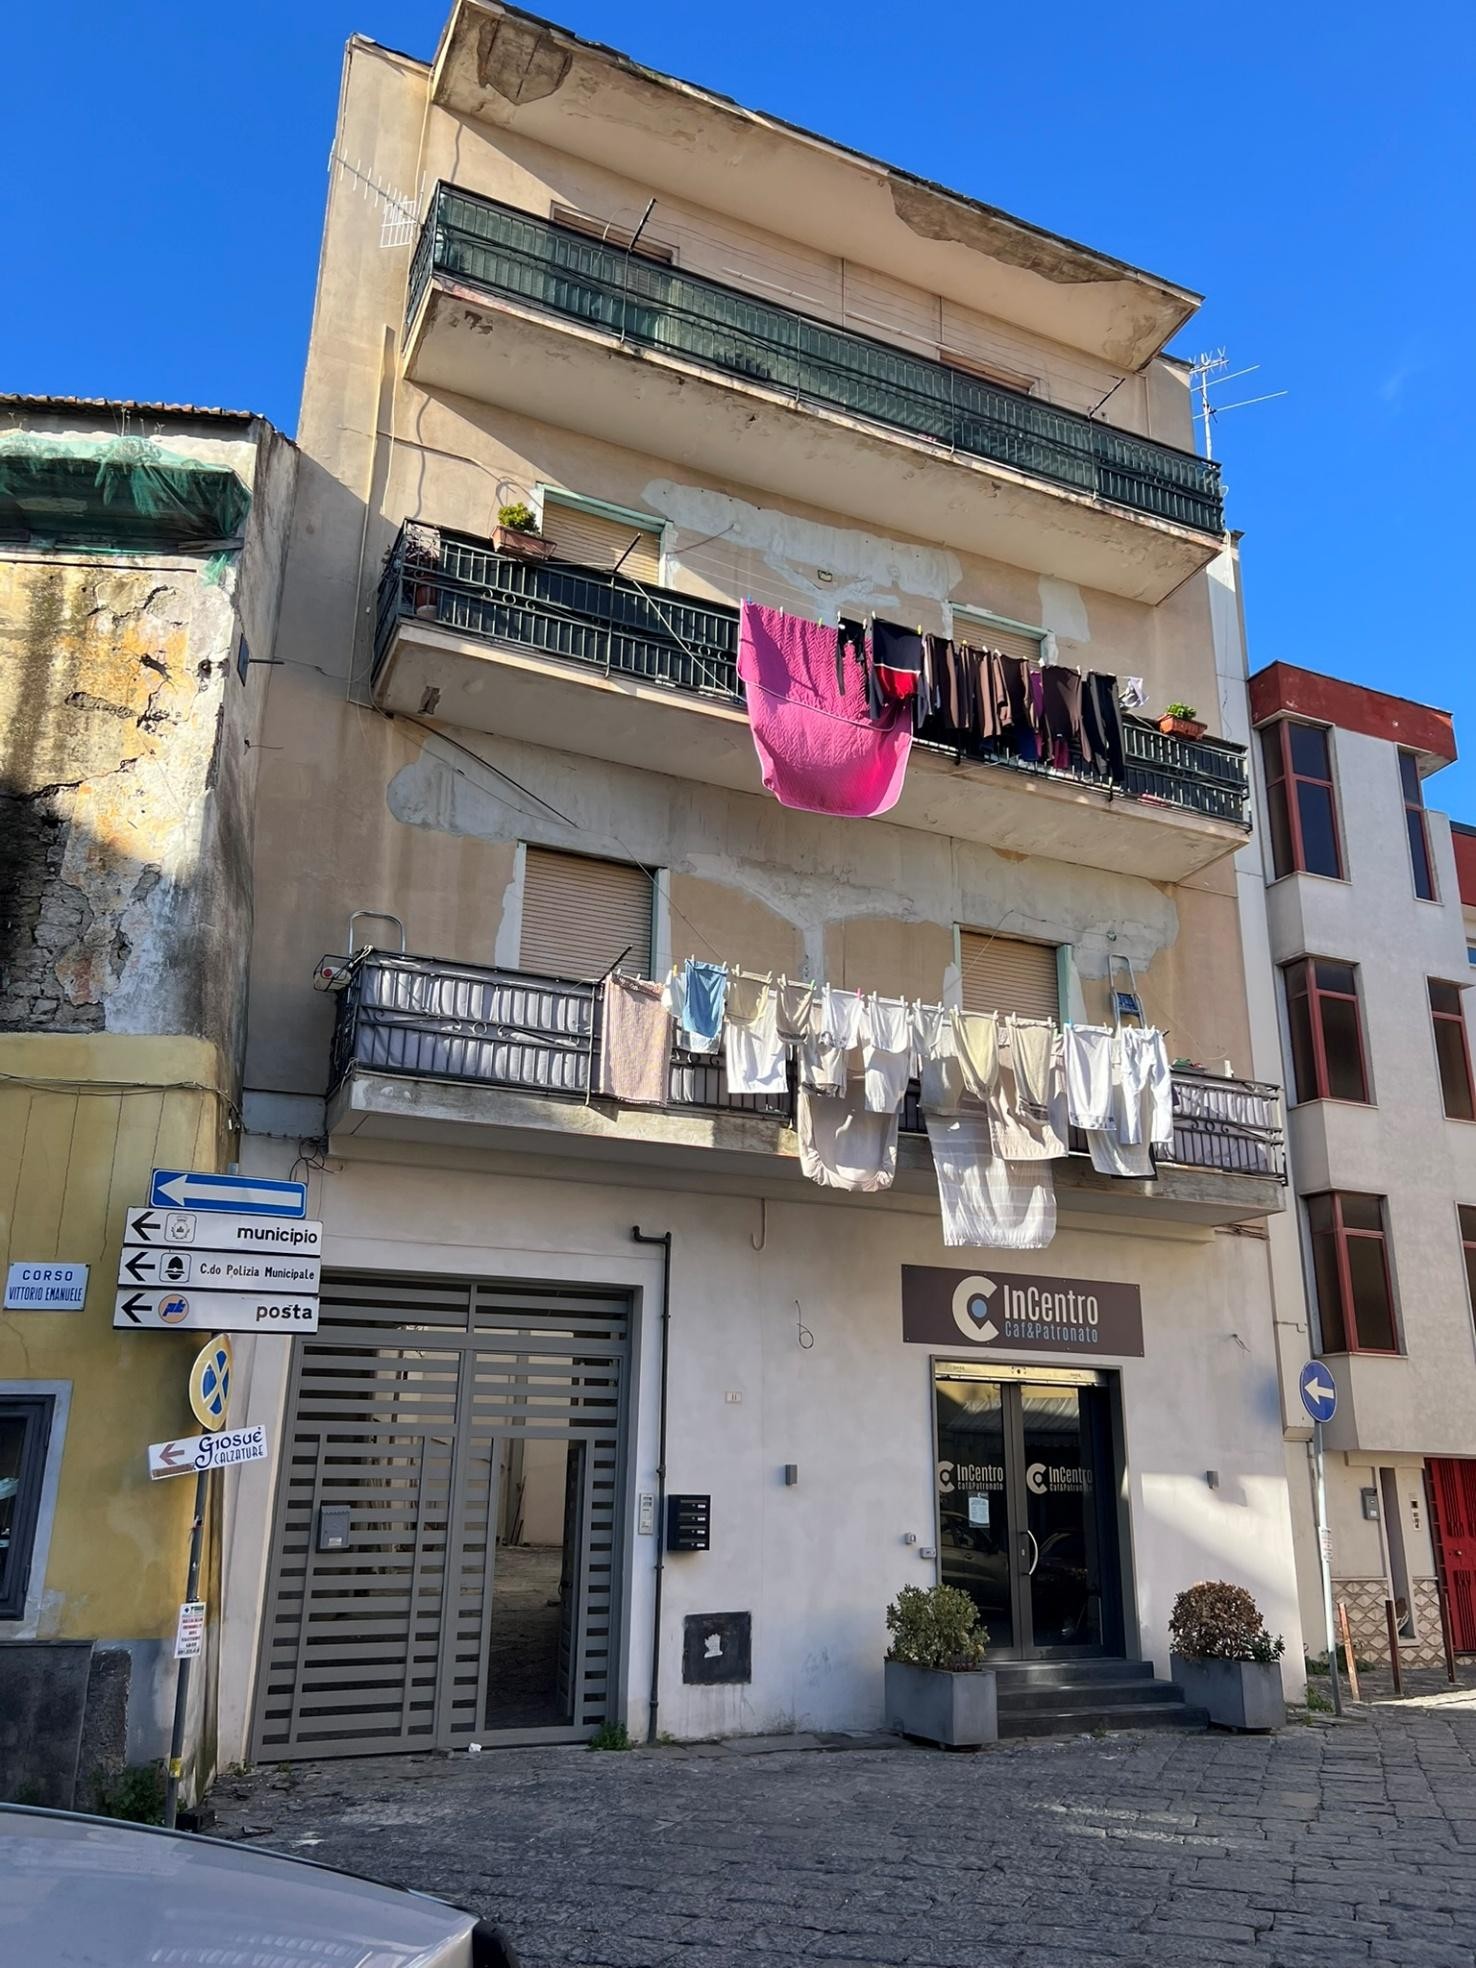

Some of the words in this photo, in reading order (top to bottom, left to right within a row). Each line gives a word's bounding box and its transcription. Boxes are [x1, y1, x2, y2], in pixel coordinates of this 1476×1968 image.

[237, 1226, 318, 1246] municipio
[22, 1269, 73, 1281] CORSO
[199, 1262, 221, 1276] C.do
[226, 1264, 260, 1277] Polizia
[264, 1266, 315, 1281] Municipale
[8, 1286, 44, 1301] VITTORIO
[45, 1287, 83, 1301] EMANUELE
[255, 1304, 313, 1322] posta
[1003, 1284, 1099, 1325] InCentro
[1004, 1320, 1098, 1343] Caf&Patronato
[214, 1445, 264, 1465] CALZATURE
[957, 1463, 1004, 1483] InCentro
[1048, 1466, 1093, 1484] InCentro
